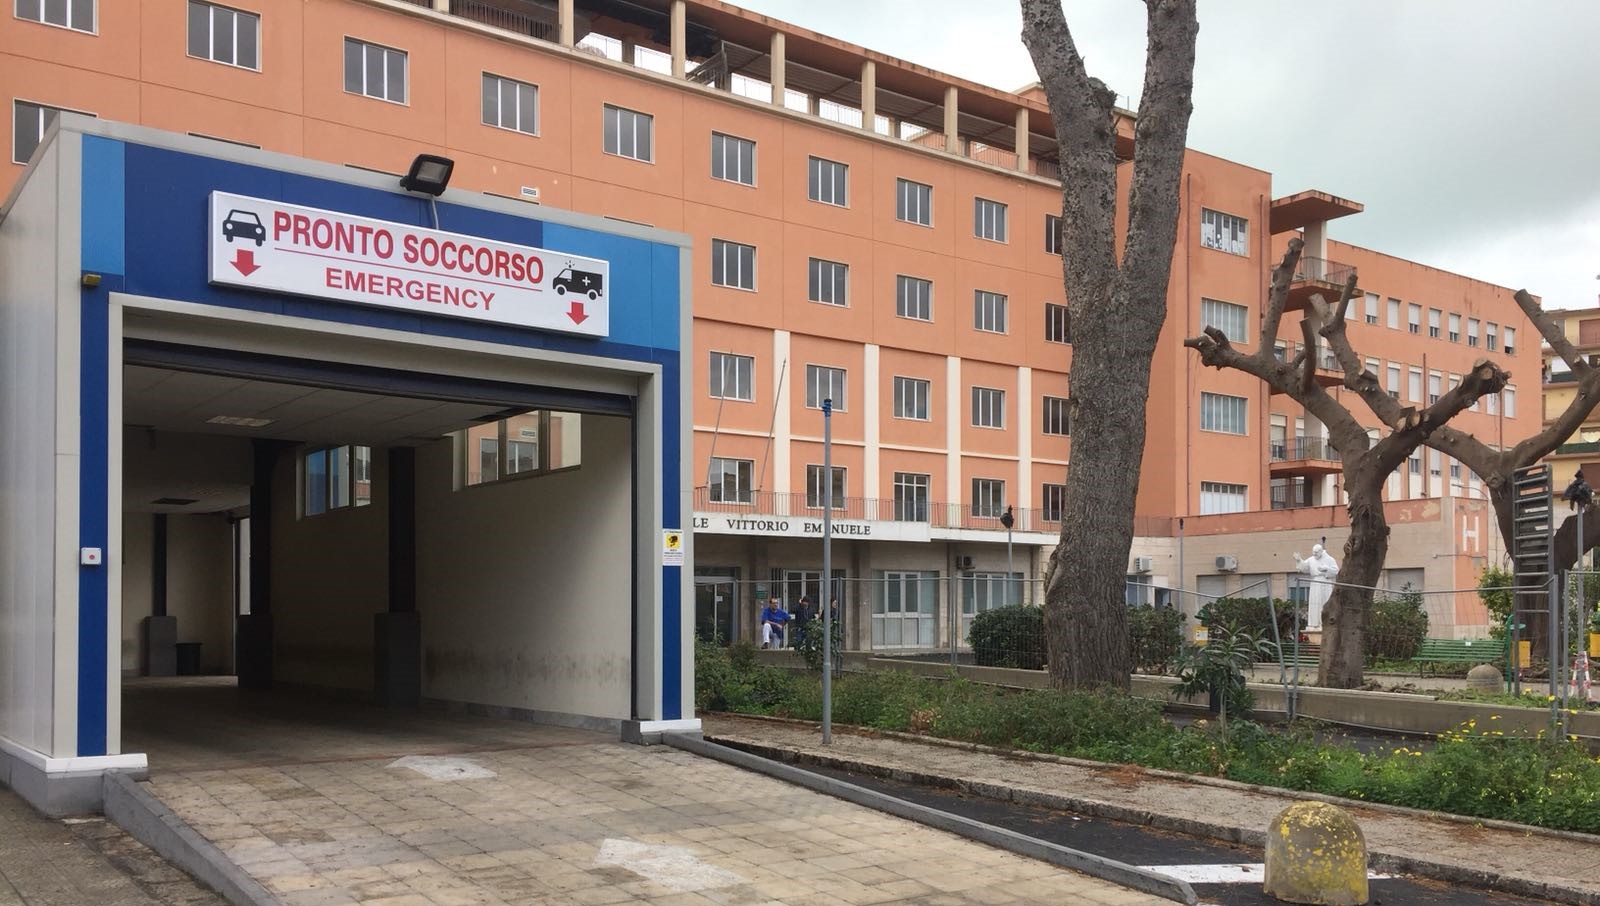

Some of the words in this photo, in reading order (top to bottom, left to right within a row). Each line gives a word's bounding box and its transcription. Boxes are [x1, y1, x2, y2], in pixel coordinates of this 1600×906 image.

[274, 210, 394, 259] PRONTO
[403, 234, 544, 284] SOCCORSO
[325, 267, 496, 311] EMERGENCY
[727, 518, 789, 532] VITTORIO
[803, 522, 872, 536] EMNUELE
[1462, 514, 1480, 553] H
